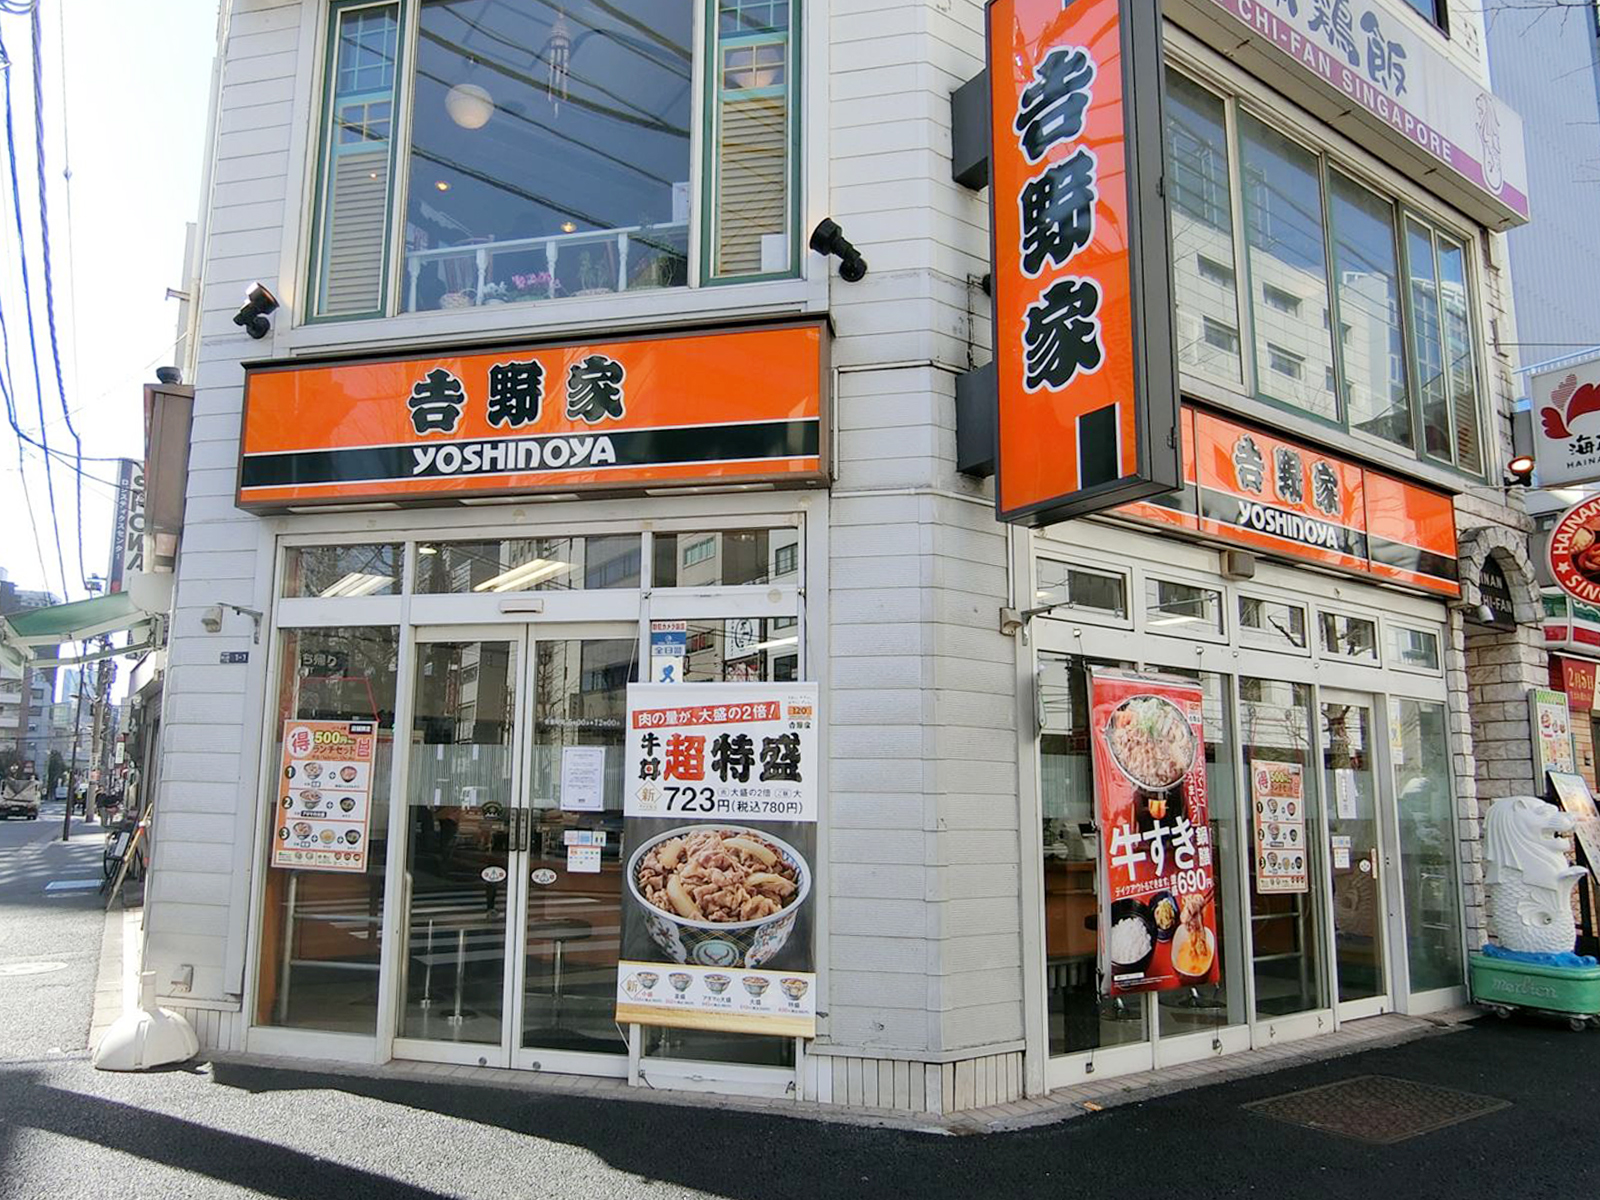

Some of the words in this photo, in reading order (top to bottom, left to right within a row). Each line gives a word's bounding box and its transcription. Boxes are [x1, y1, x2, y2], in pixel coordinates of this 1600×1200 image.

[1238, 0, 1331, 78] CHI-FAN
[1342, 70, 1452, 161] SINGAPORE
[413, 436, 616, 475] YOSHINOYA
[1569, 434, 1600, 456] 海
[1238, 500, 1339, 549] YOSHINOYA
[664, 732, 803, 783] 超特盛
[1109, 816, 1196, 881] 牛すき
